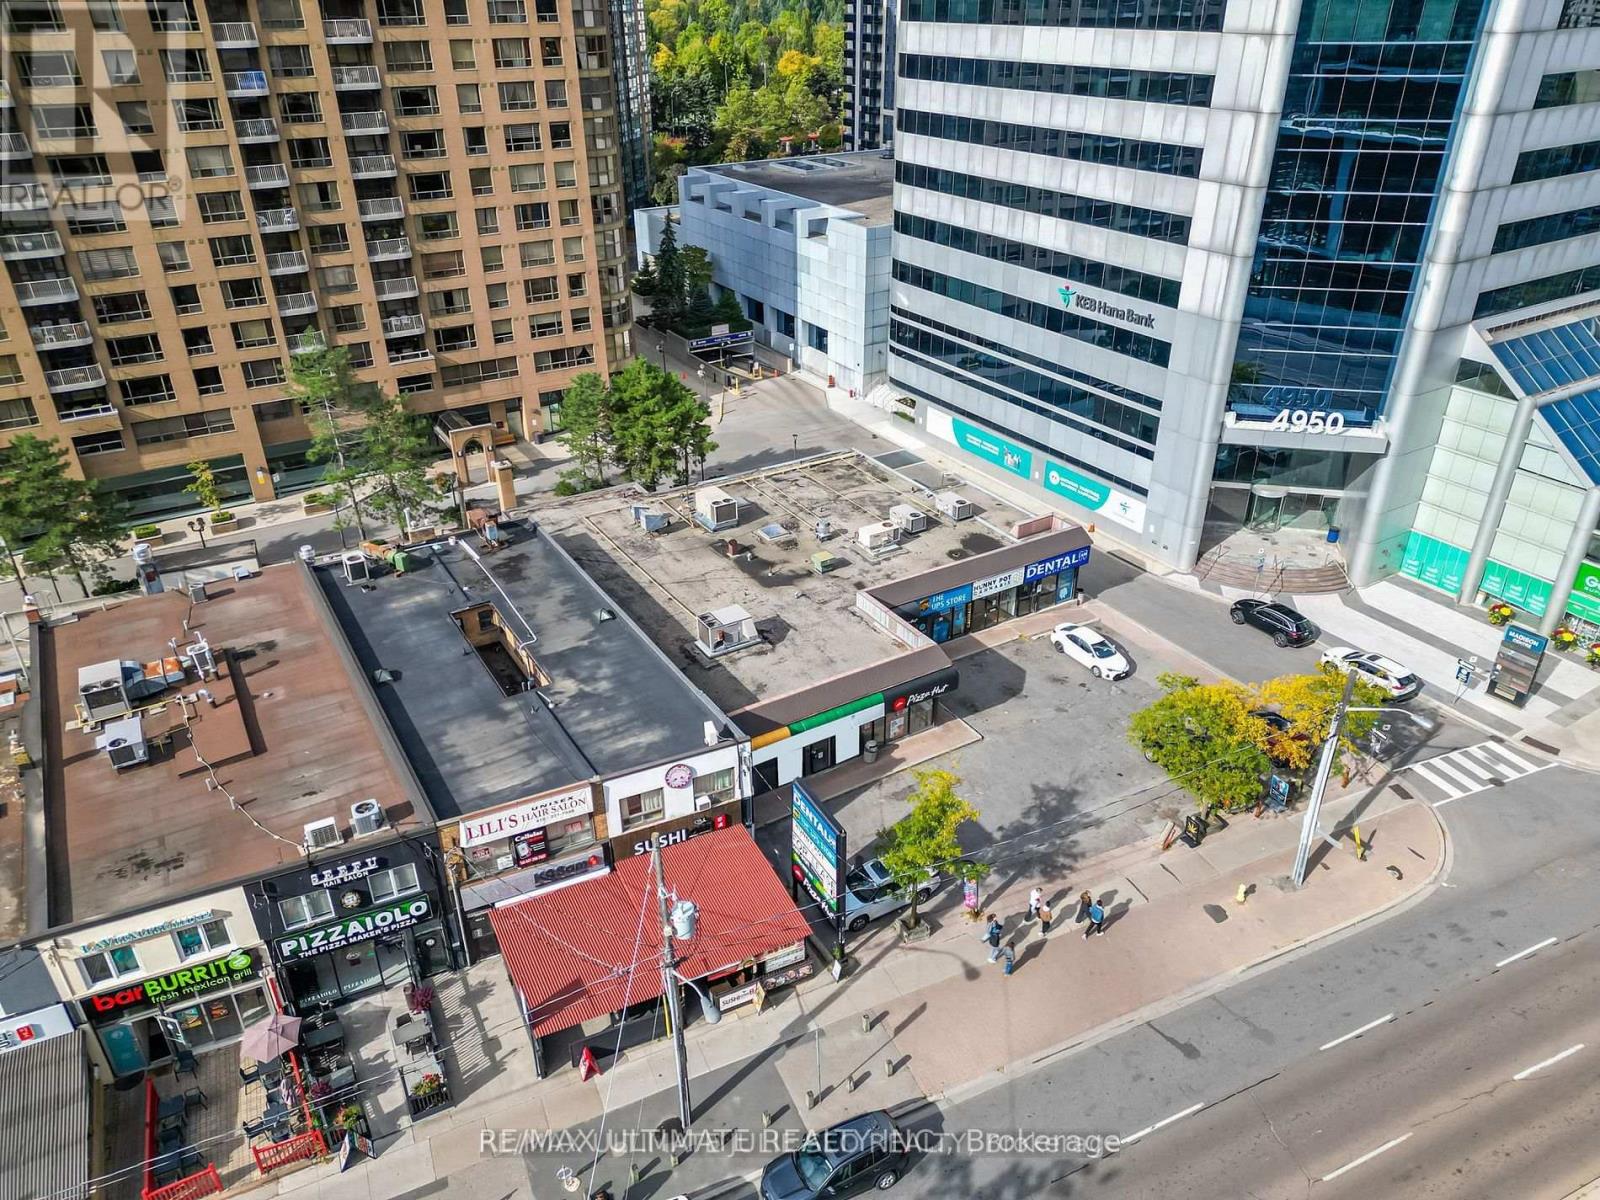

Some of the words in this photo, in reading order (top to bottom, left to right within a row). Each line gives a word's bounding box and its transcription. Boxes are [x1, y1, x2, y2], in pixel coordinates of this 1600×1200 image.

[1075, 294, 1098, 313] KEB
[1098, 300, 1125, 320] Hana
[1126, 308, 1155, 329] Bank
[1271, 409, 1344, 435] 4950
[1027, 554, 1079, 579] DENTAL
[973, 579, 997, 592] HUNNY
[999, 574, 1012, 585] POT
[931, 600, 945, 611] UPS
[946, 593, 966, 606] STORE
[932, 593, 944, 603] THE
[1508, 630, 1539, 647] MADISON
[906, 691, 930, 706] Pizza
[931, 683, 949, 697] Hut
[531, 796, 574, 811] UNISEX
[467, 814, 519, 841] LILI'S
[521, 808, 550, 823] HAIR
[550, 797, 587, 814] SALON
[793, 795, 832, 843] DENTAL
[514, 829, 544, 842] Cellular
[634, 829, 687, 856] SUSHI
[322, 878, 342, 888] HAIR
[343, 870, 369, 884] SALON
[280, 901, 428, 957] PIZZAIOLO
[298, 949, 318, 960] THE
[319, 940, 347, 954] PIZZA
[350, 926, 390, 944] MAKER'S
[390, 918, 418, 933] PIZZA
[151, 990, 179, 1004] fresh
[183, 976, 230, 994] mexican
[234, 968, 253, 982] grill
[92, 985, 145, 1013] bar
